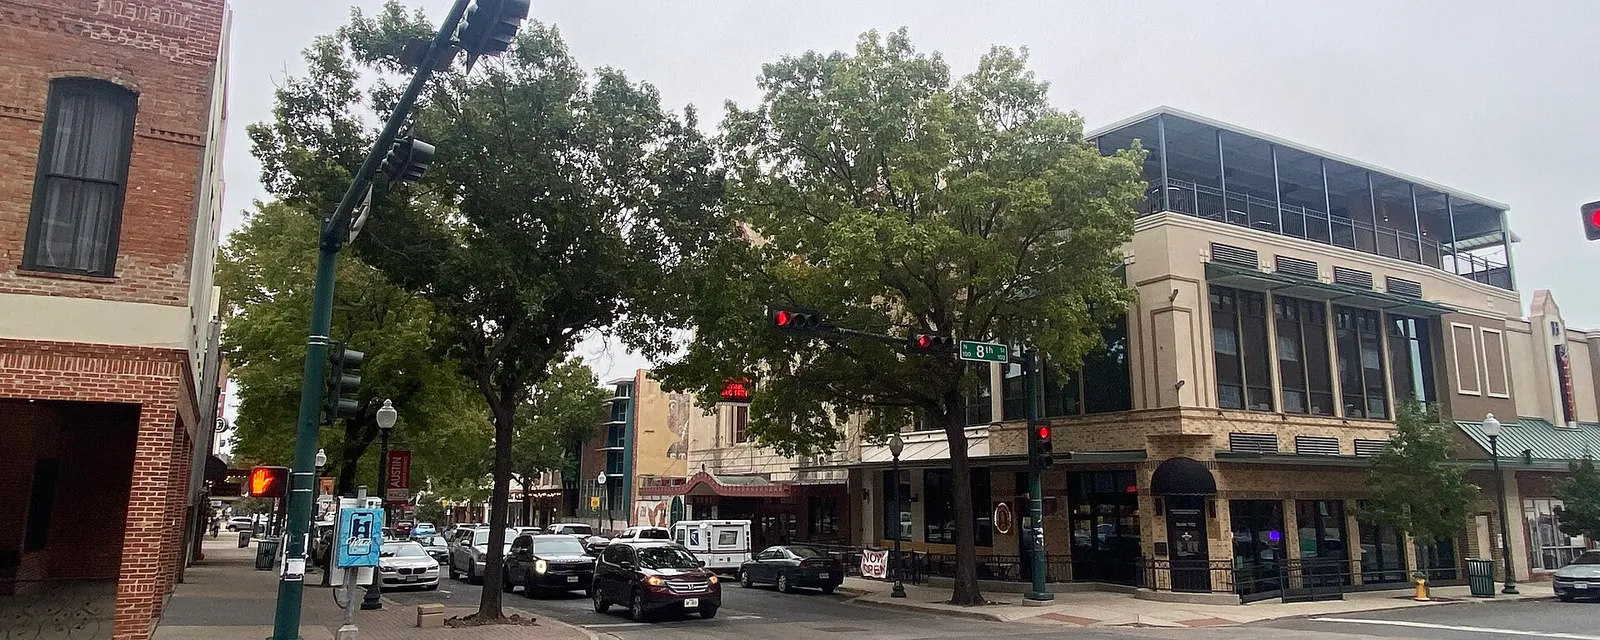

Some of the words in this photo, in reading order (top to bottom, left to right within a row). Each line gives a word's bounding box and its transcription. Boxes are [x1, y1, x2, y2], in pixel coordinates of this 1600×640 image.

[976, 345, 994, 358] 8th
[390, 456, 402, 488] AUSTIN
[863, 552, 886, 564] NOW
[863, 564, 886, 576] OPEN
